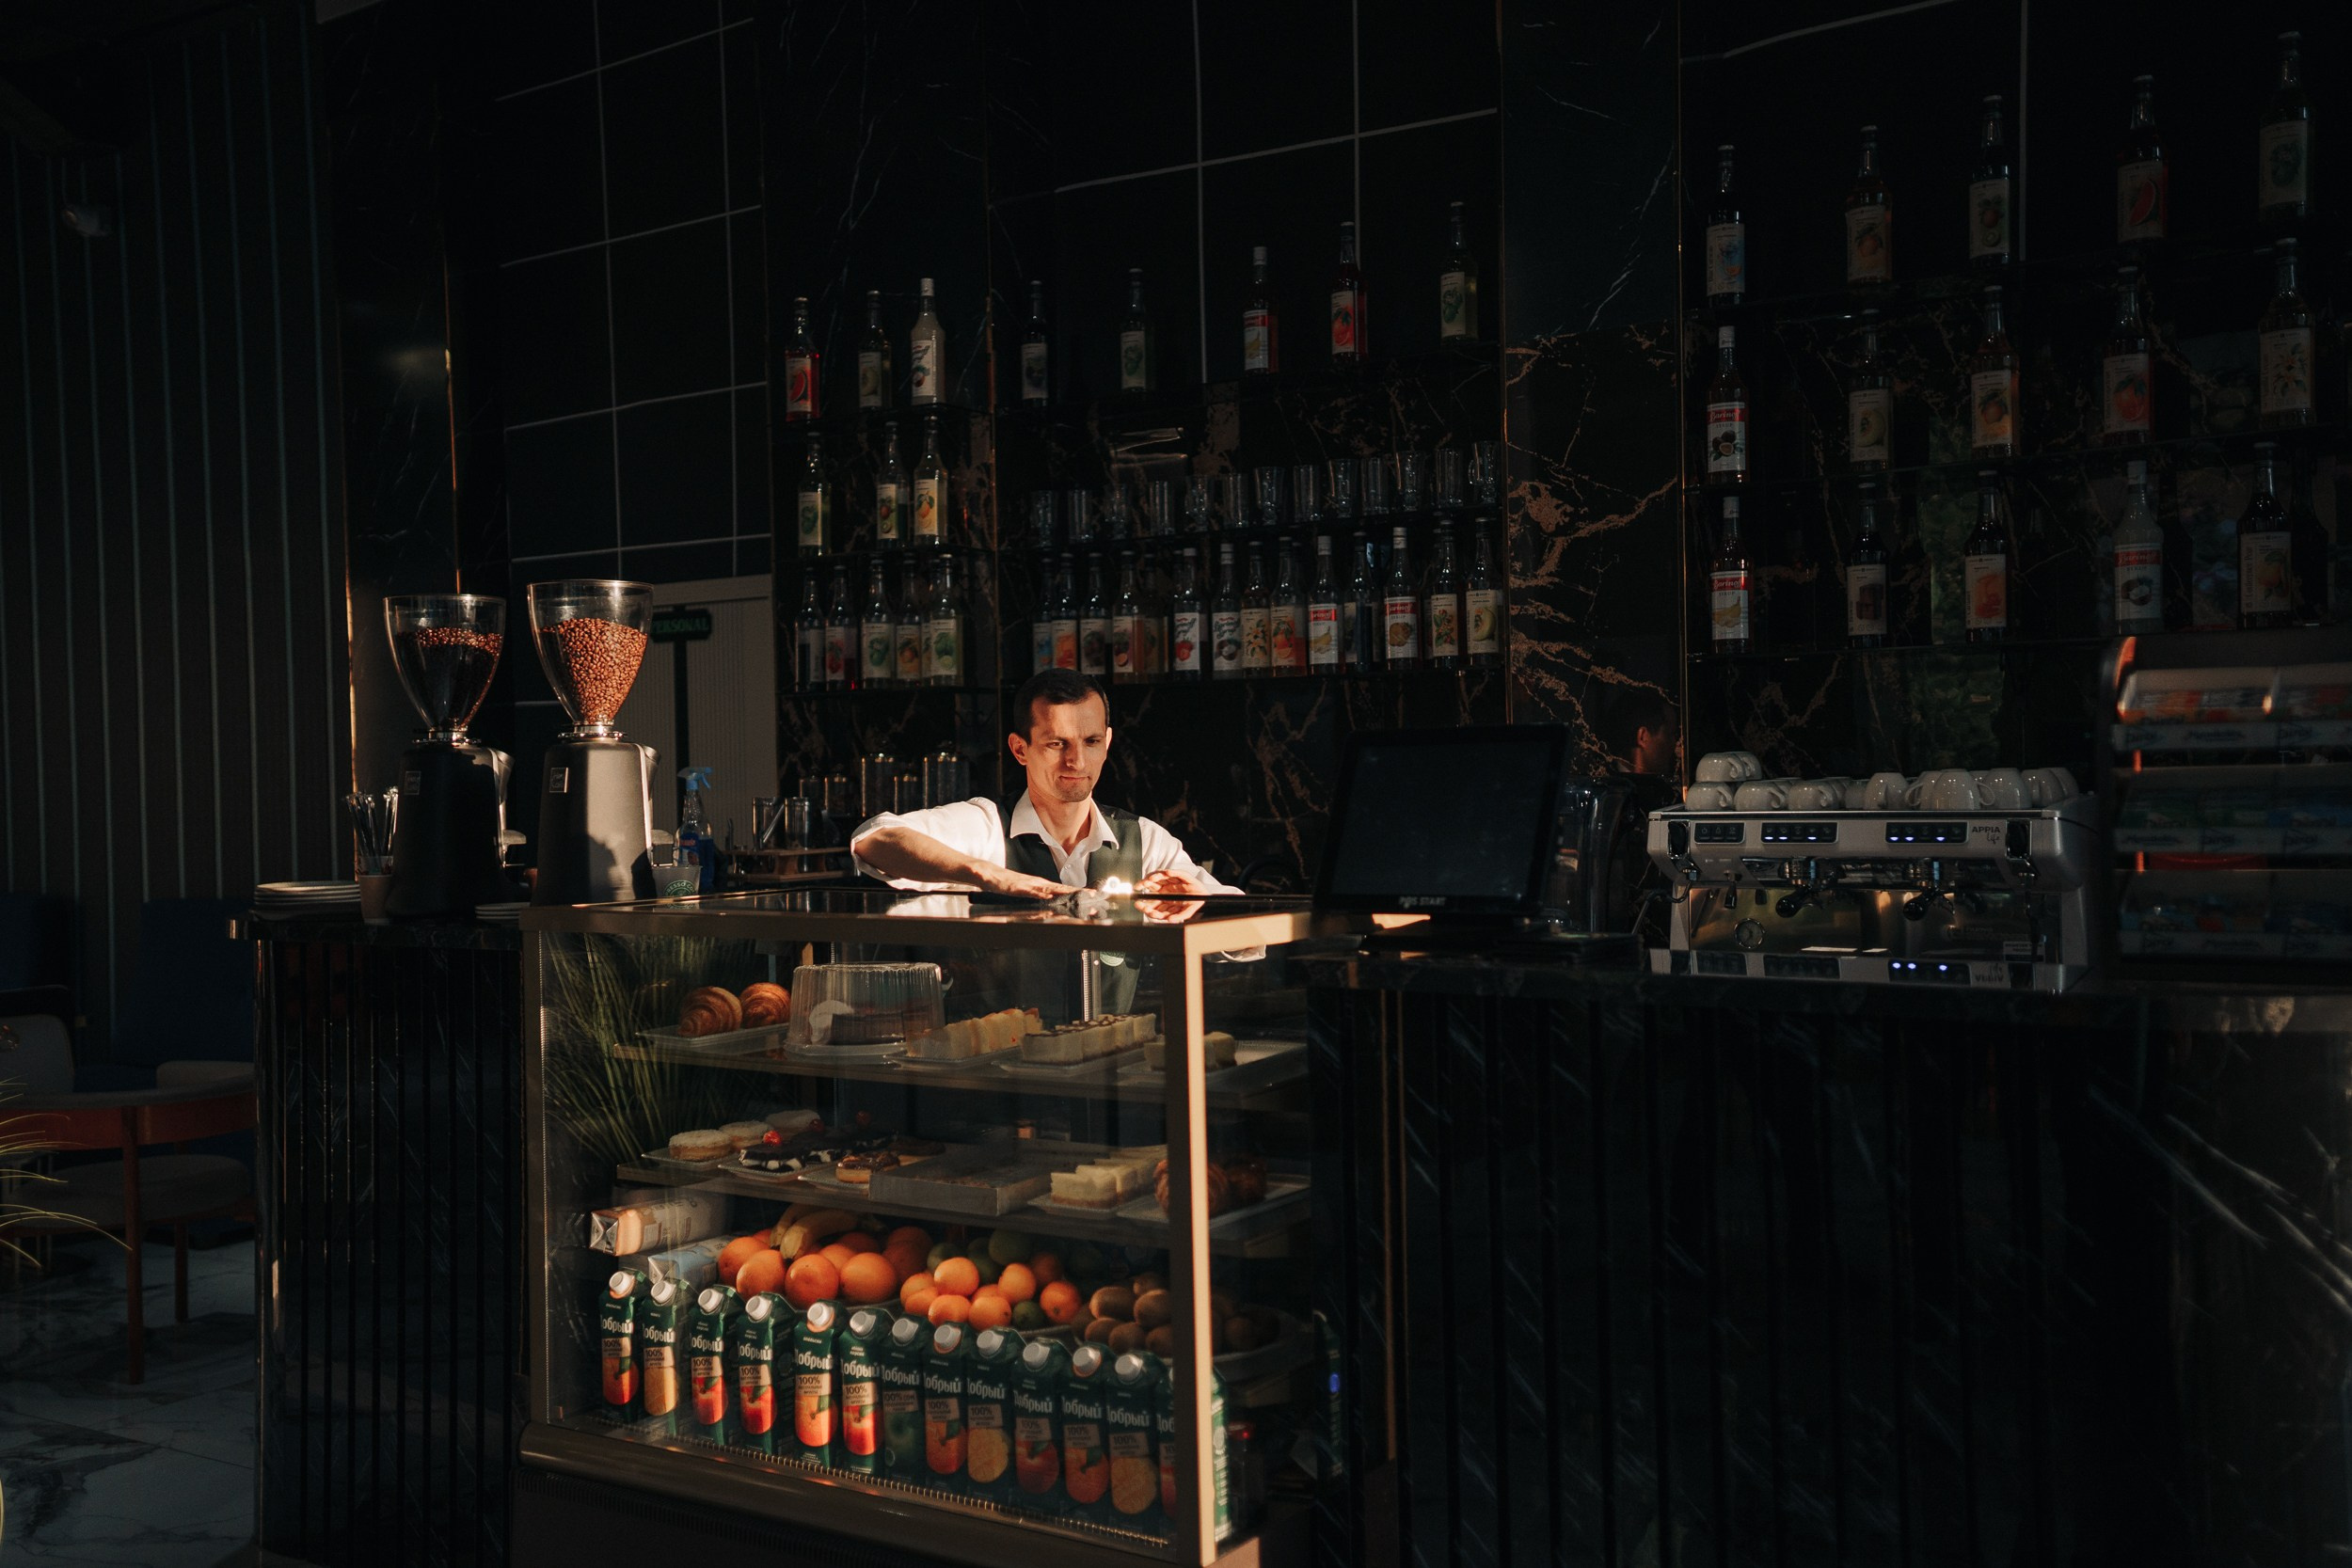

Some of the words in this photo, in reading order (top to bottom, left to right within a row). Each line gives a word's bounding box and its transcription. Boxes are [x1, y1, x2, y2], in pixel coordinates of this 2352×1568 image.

[693, 1358, 712, 1367] 100%
[740, 1367, 760, 1375] 100%
[799, 1374, 821, 1385] 100%
[846, 1385, 866, 1395] 100%
[971, 1406, 993, 1416] 100%
[1113, 1434, 1136, 1445] 100%
